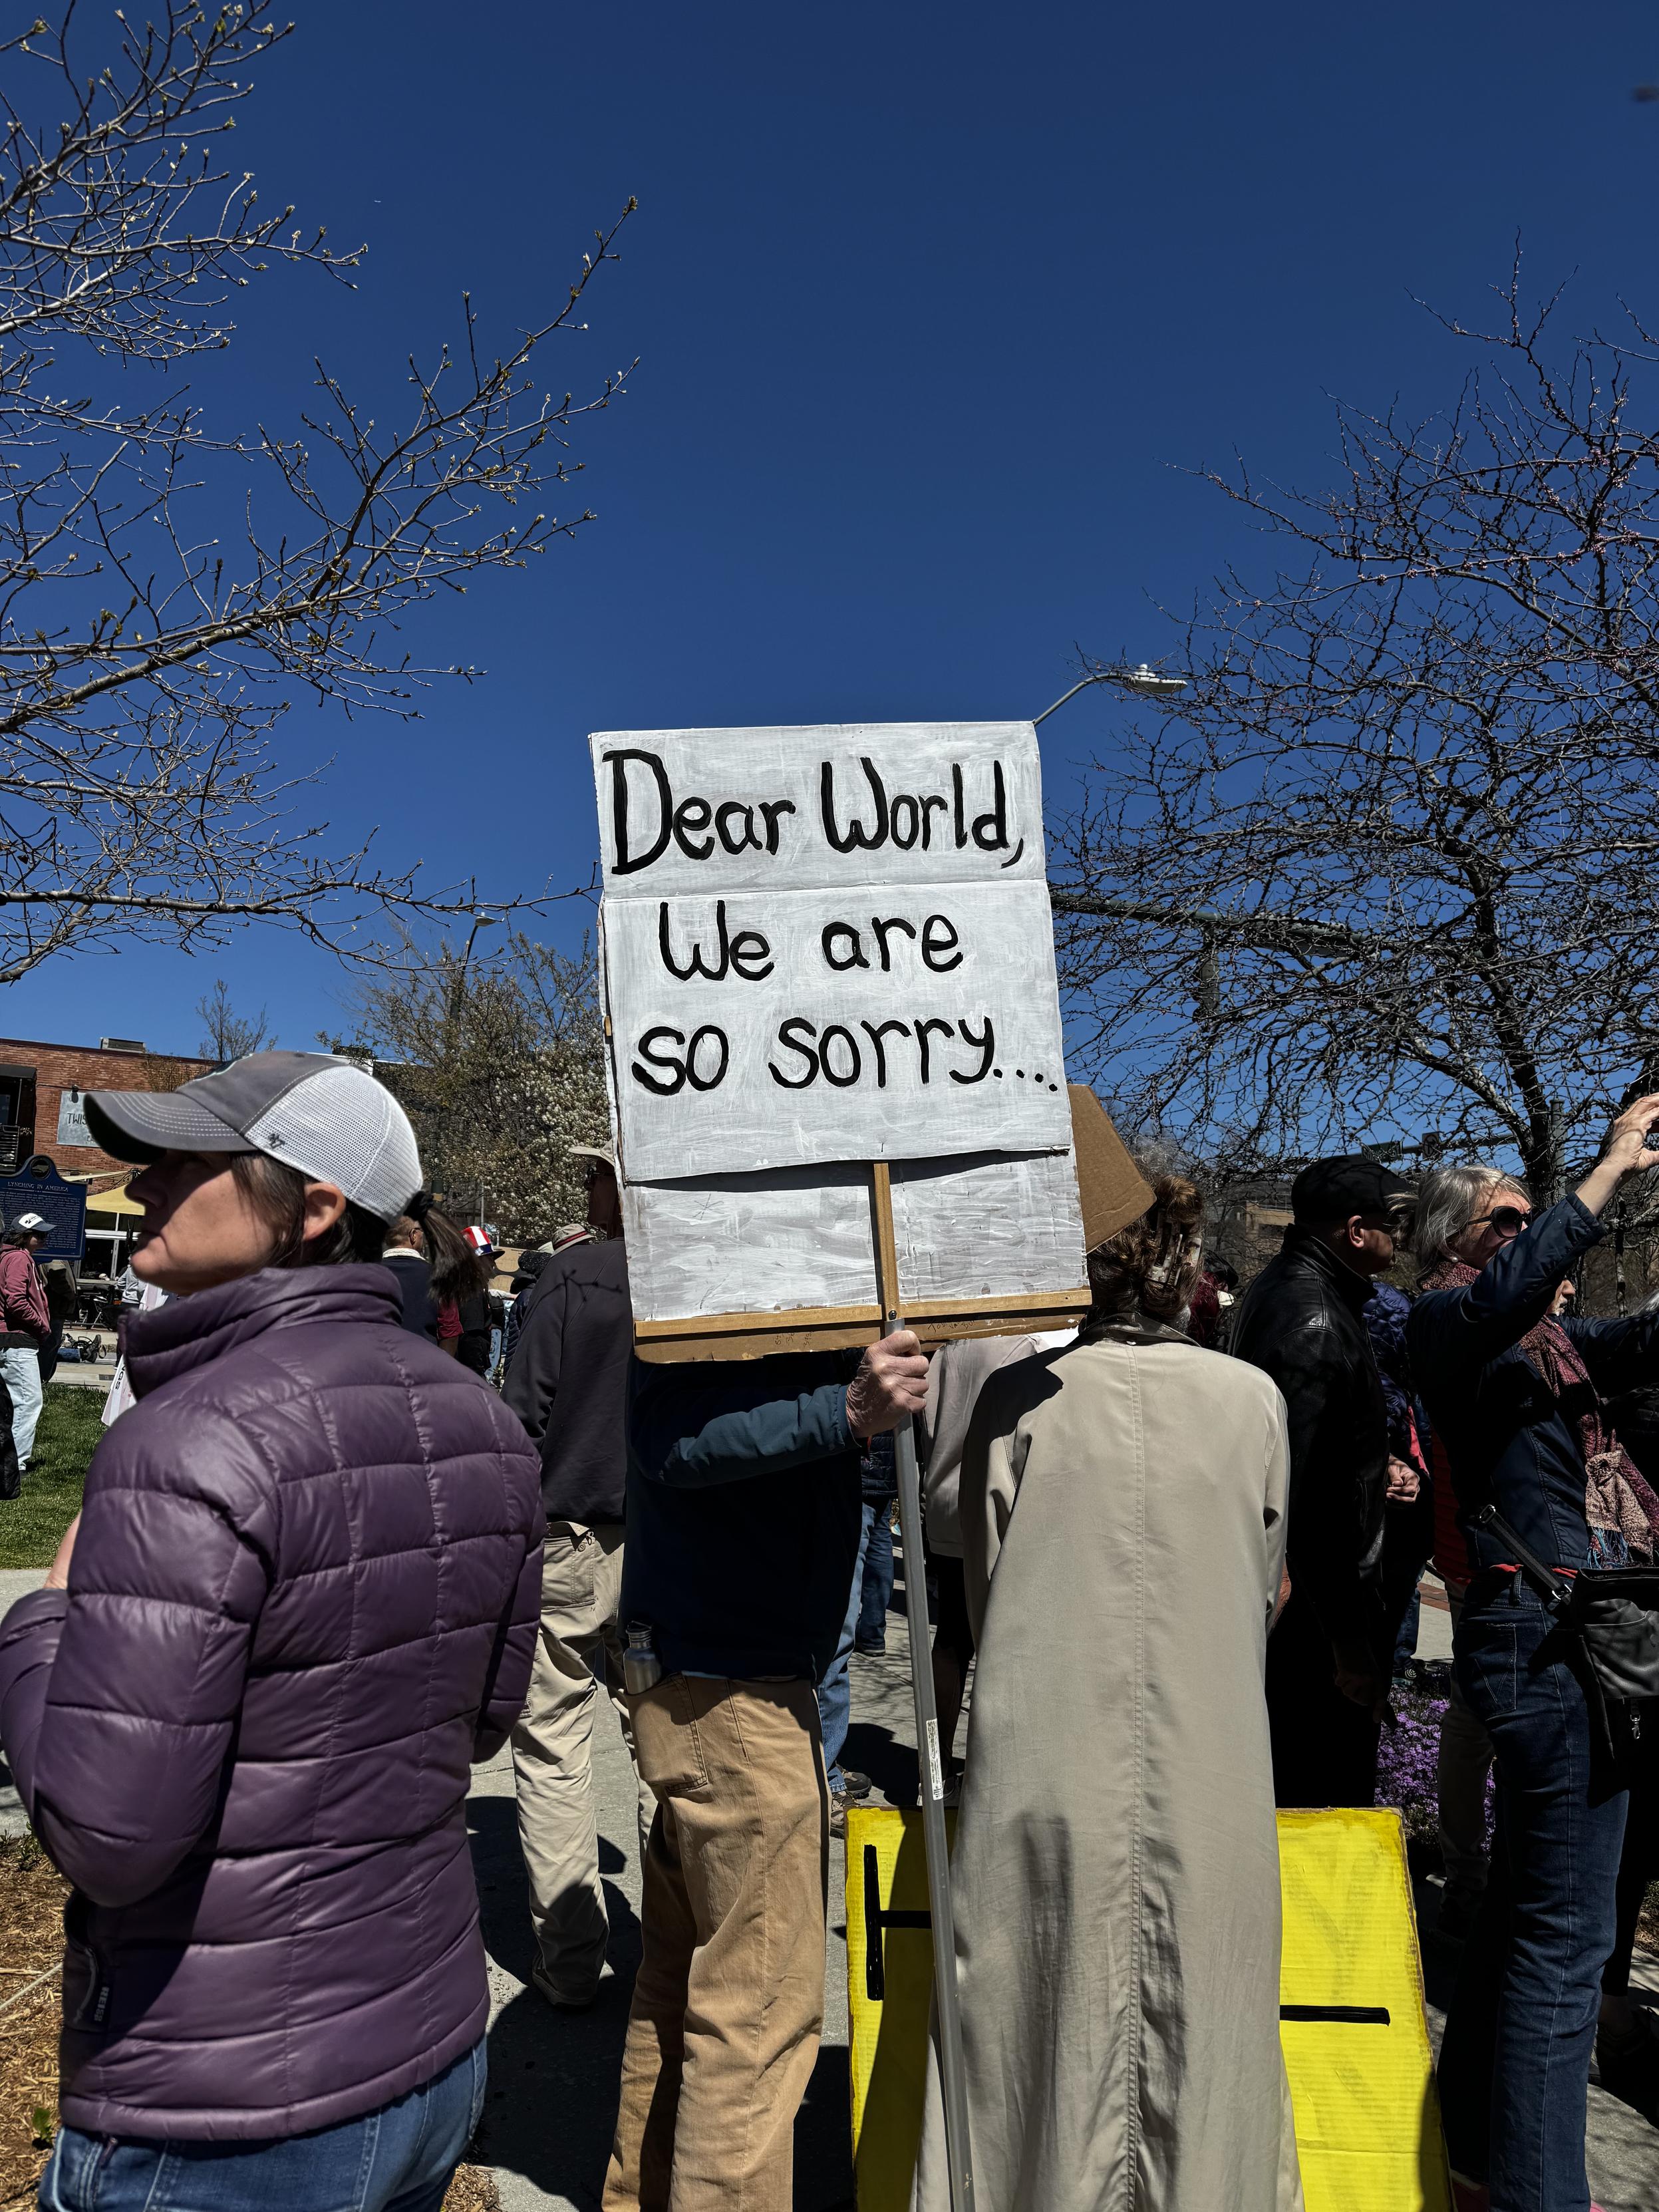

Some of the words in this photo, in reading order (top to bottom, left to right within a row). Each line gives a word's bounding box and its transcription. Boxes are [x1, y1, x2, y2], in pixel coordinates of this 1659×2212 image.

[602, 748, 796, 875] Dear
[821, 757, 1024, 868] World,
[659, 900, 774, 981] We
[822, 915, 963, 972] are
[632, 1025, 729, 1095] so
[768, 1017, 1059, 1091] sorry....
